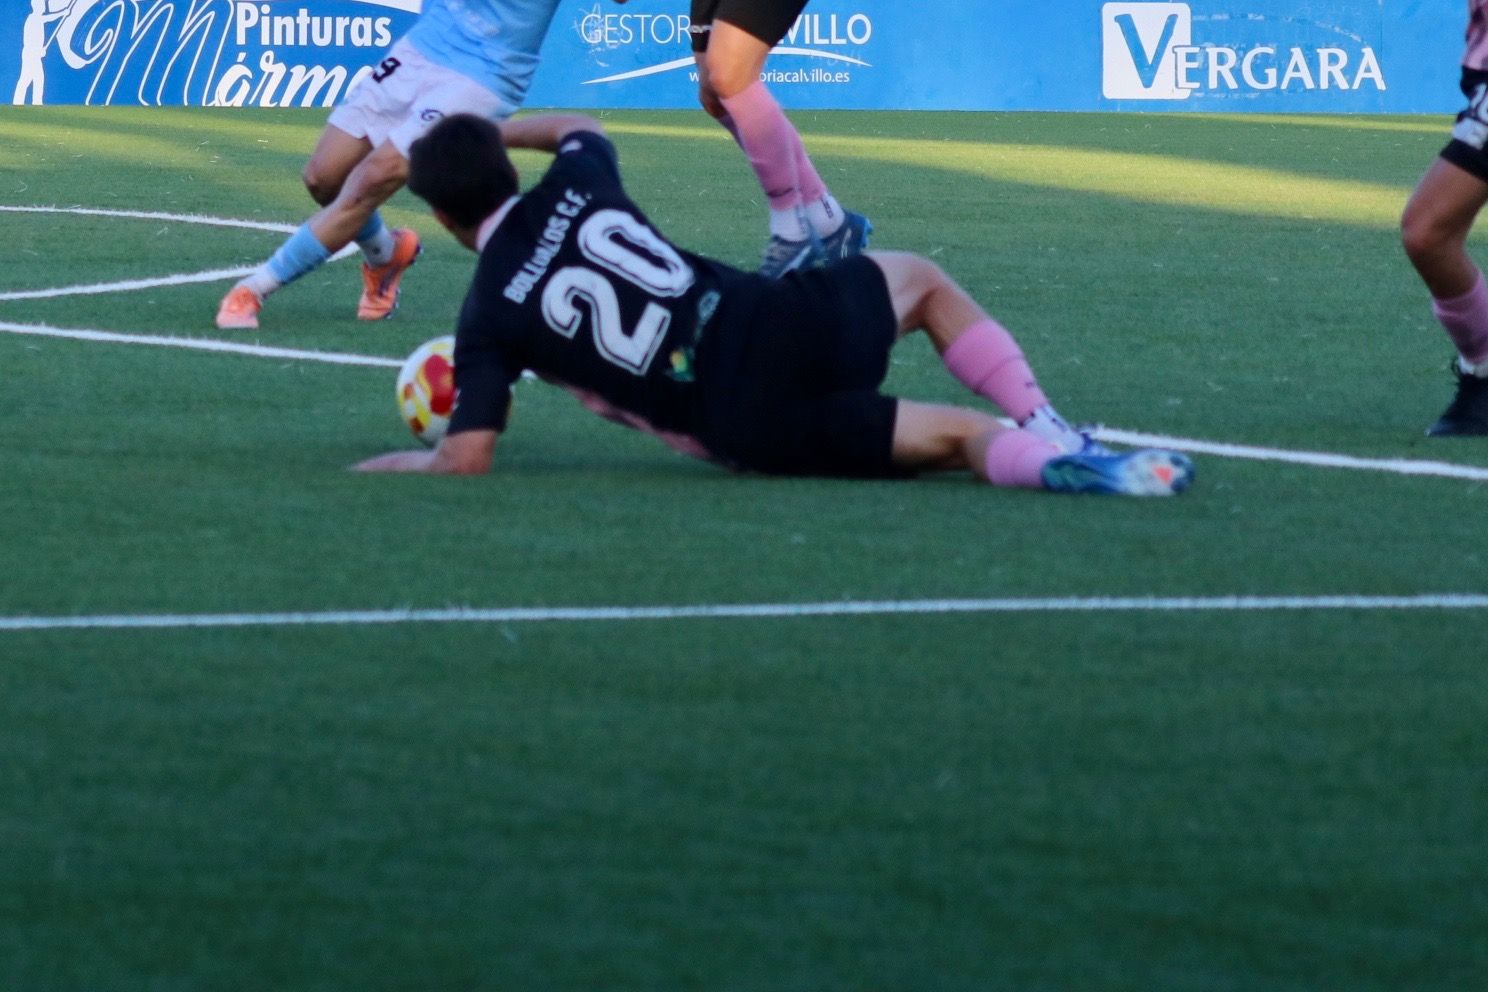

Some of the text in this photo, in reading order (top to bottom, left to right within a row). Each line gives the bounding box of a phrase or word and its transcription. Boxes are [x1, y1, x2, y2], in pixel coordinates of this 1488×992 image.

[236, 2, 392, 47] Pinturas
[581, 13, 691, 44] GESTOR
[373, 57, 402, 83] 9
[1114, 12, 1387, 91] VERGARA
[541, 208, 696, 377] 20
